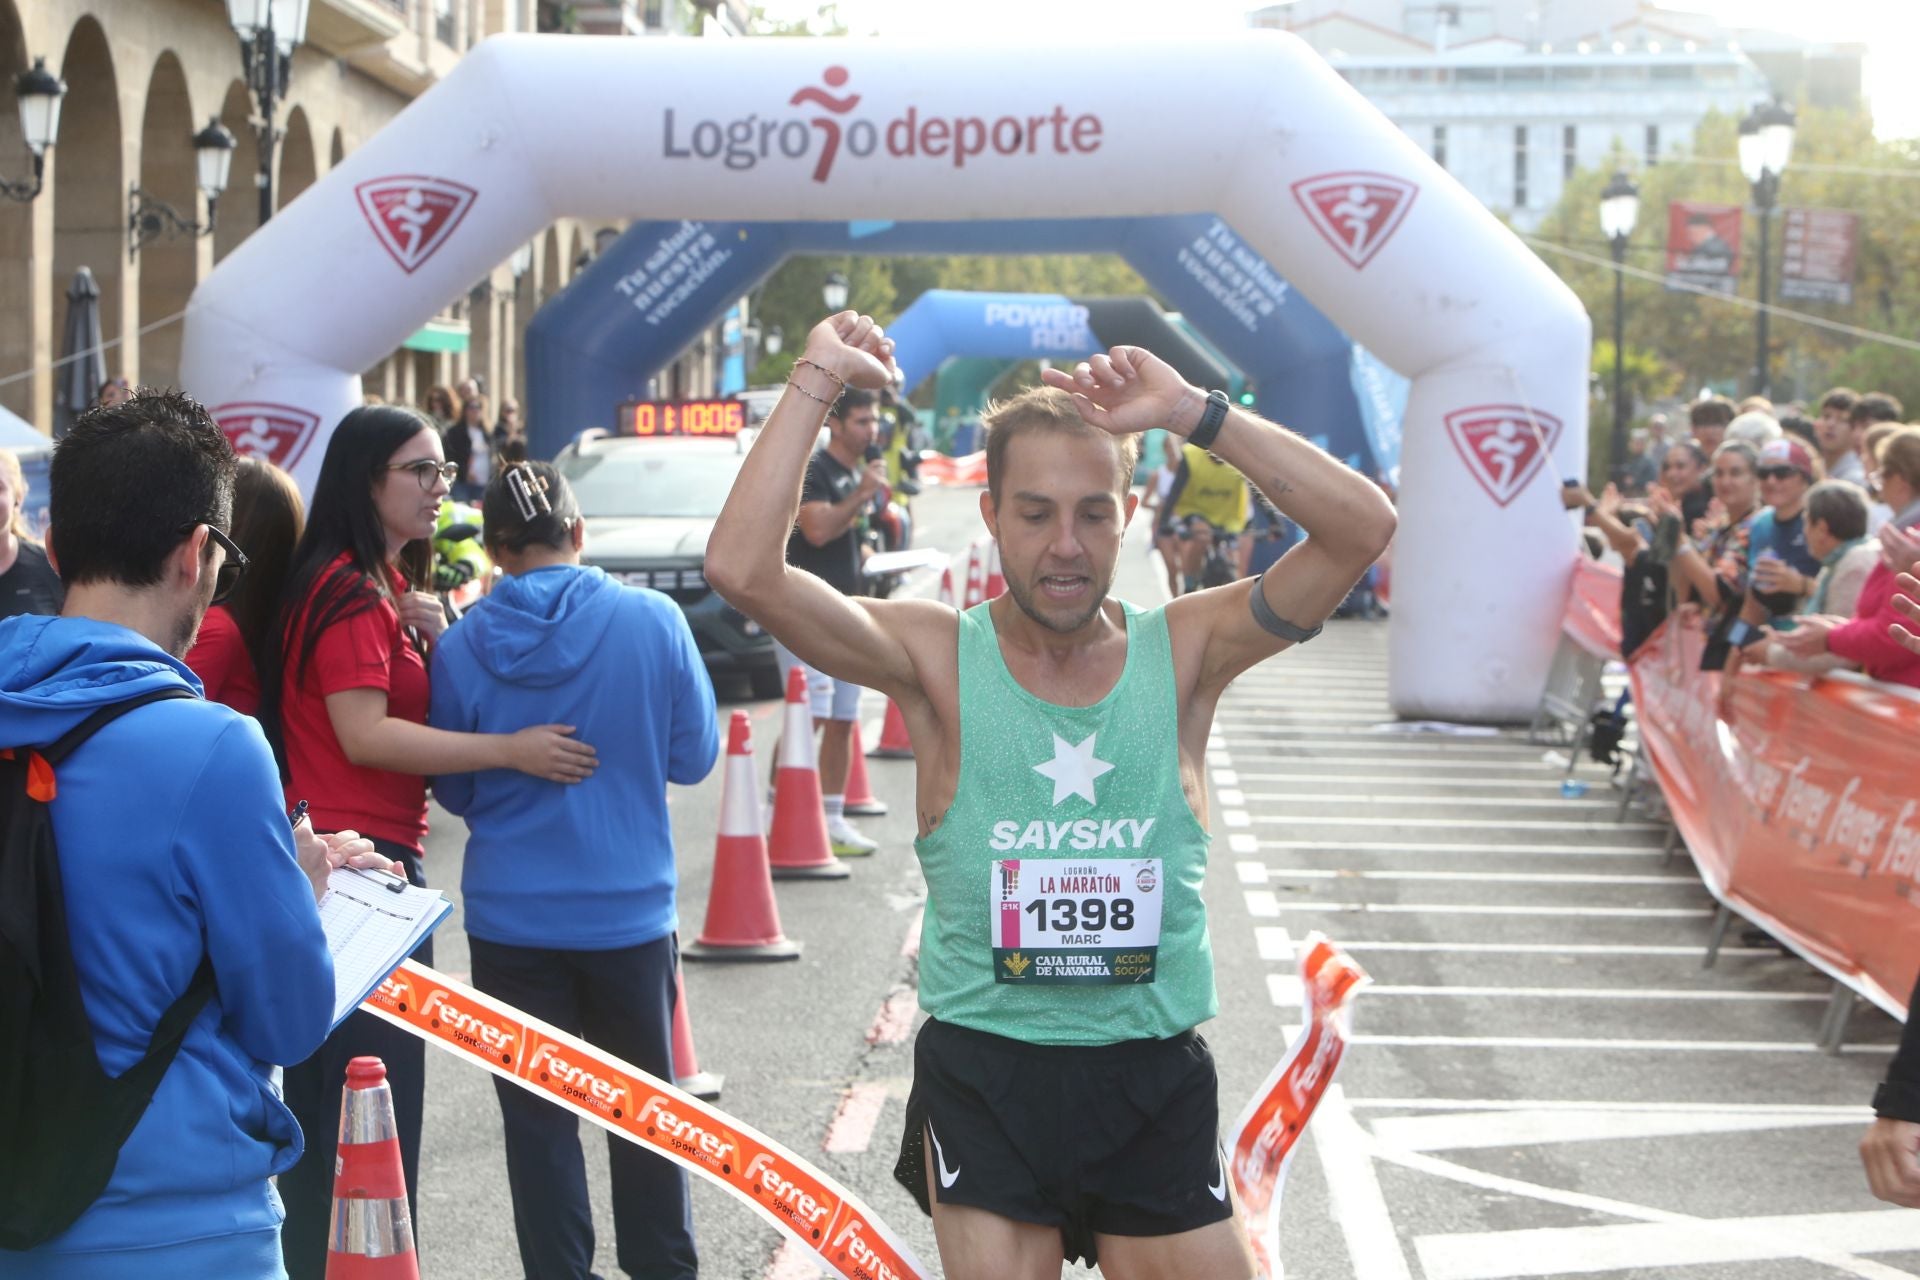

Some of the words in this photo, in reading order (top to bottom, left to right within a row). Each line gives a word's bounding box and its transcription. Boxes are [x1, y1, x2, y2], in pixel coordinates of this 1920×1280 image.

[886, 105, 1104, 168] deporte
[1208, 217, 1235, 251] Tu
[614, 269, 647, 297] Tu
[634, 232, 716, 311] nuestra
[1191, 235, 1275, 317] nuestra
[984, 303, 1091, 328] POWER
[989, 818, 1156, 850] SAYSKY
[1040, 876, 1056, 894] LA
[1060, 873, 1121, 894] MARATÓN
[1063, 866, 1098, 876] LOGROÑO
[1002, 903, 1019, 911] 21K
[1025, 898, 1135, 932] 1398
[1061, 934, 1102, 945] MARC
[1035, 955, 1065, 967] CAJA
[1066, 955, 1106, 966] RURAL
[1035, 967, 1053, 976] DE
[1055, 966, 1111, 976] NAVARRA
[1114, 953, 1151, 964] ACCIÓN
